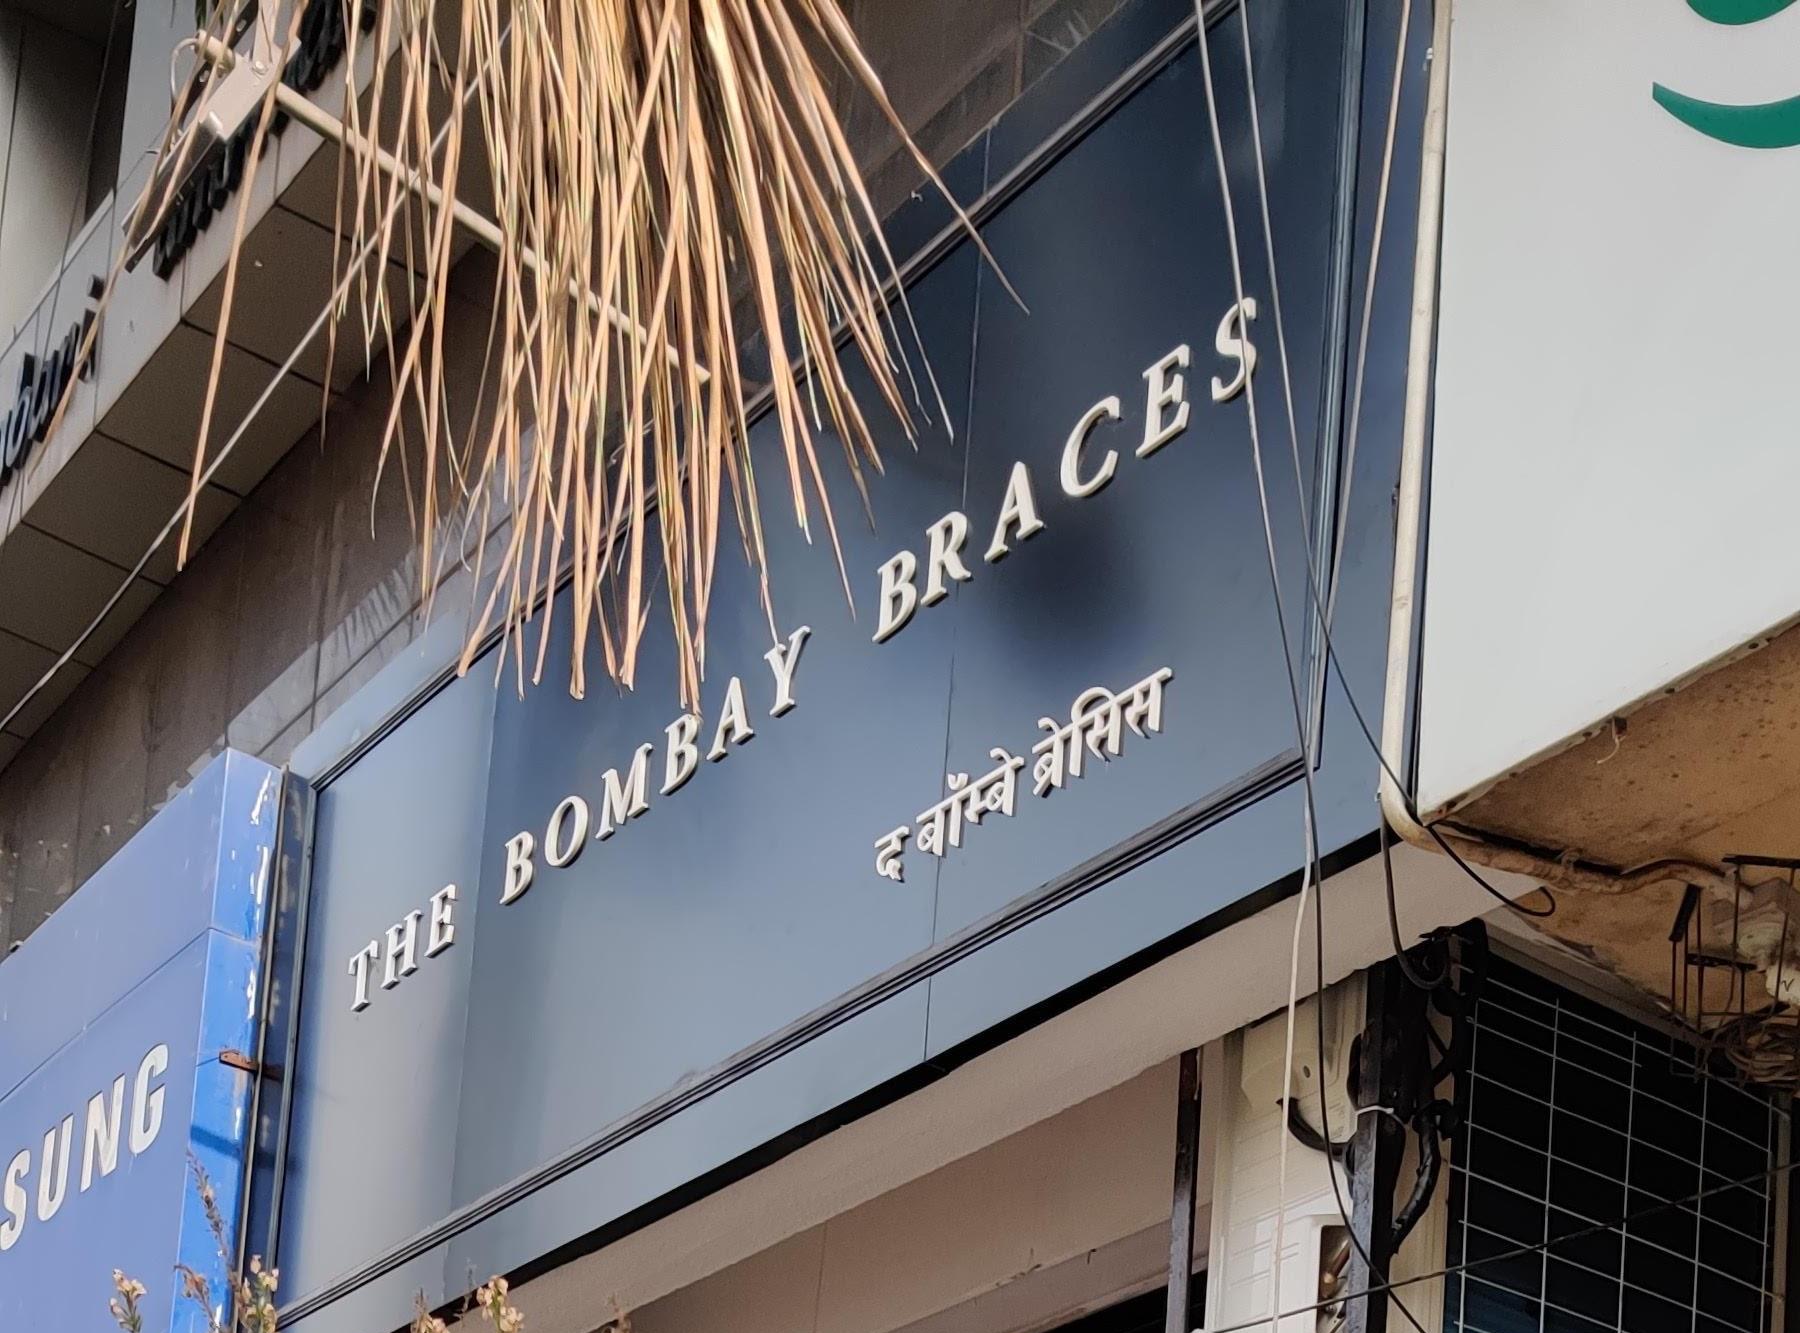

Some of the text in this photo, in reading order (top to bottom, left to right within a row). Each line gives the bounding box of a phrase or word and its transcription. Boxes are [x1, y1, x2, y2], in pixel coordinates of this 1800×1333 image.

[348, 297, 1257, 1012] THE BOMBAY BRACES
[875, 667, 1174, 882] द बॉम्बे ब्रेसिस
[0, 1043, 168, 1251] SUNG
